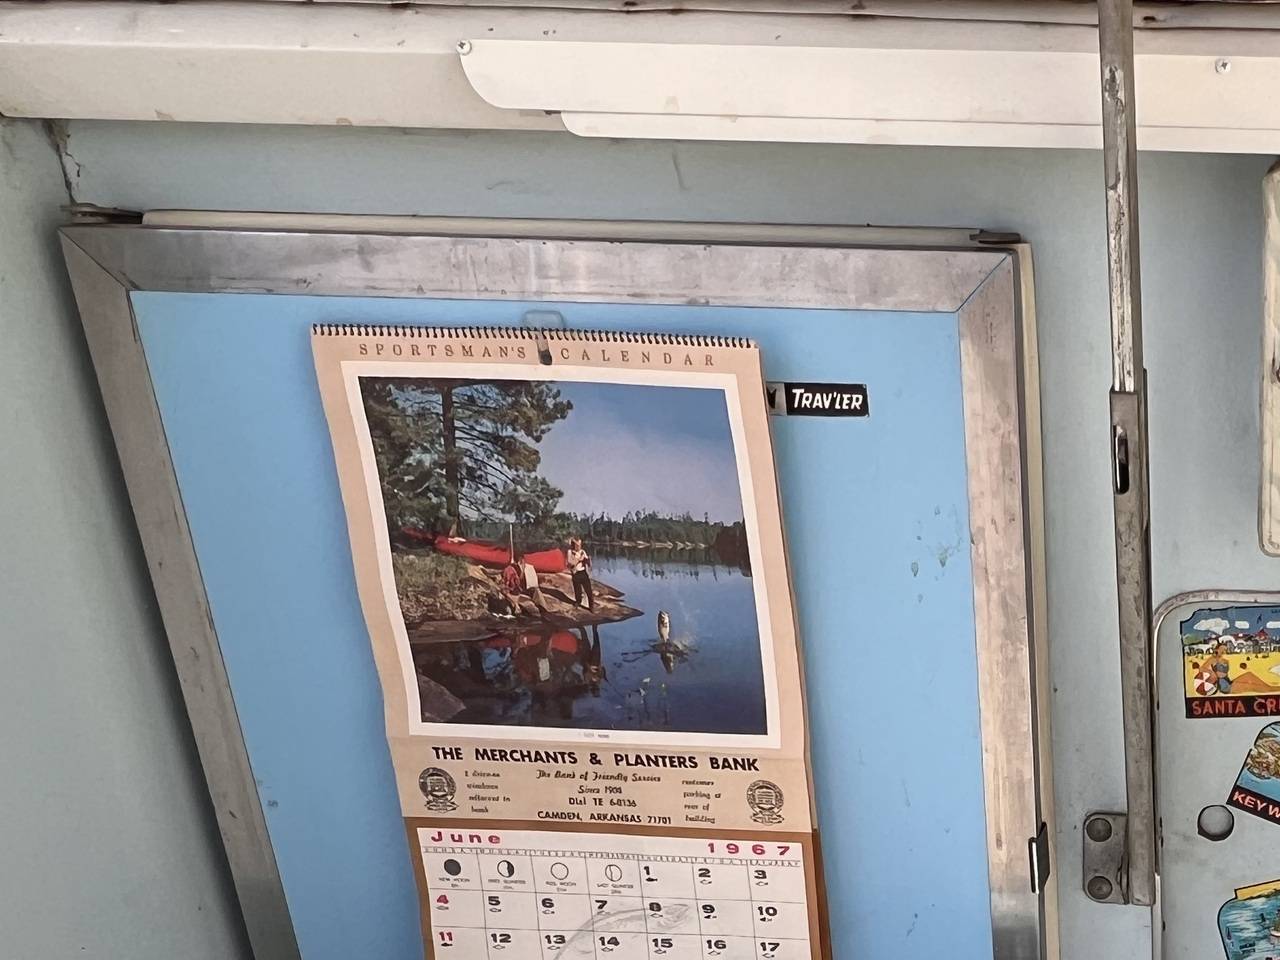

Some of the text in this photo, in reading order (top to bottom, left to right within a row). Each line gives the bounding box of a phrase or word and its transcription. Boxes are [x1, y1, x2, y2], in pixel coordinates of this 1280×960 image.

[359, 343, 715, 367] SPORTSMAN'S CALENDAR
[1192, 700, 1246, 716] SANTA
[432, 746, 761, 772] THE MERCHANTS & PLANTERS BANK
[536, 769, 551, 779] The
[579, 771, 589, 781] of
[592, 771, 629, 783] Friendly
[631, 773, 662, 782] Service
[592, 798, 603, 806] TE
[1232, 789, 1267, 812] KEY
[537, 810, 583, 821] CAMDEN,
[589, 812, 642, 823] ARKANSAS
[431, 831, 501, 845] June
[707, 842, 791, 857] 1967
[643, 865, 767, 880] 1 2 3
[436, 894, 778, 917] 4 5 6 7 8 9 10
[438, 931, 780, 952] 11 12 13 14 15 16 17
